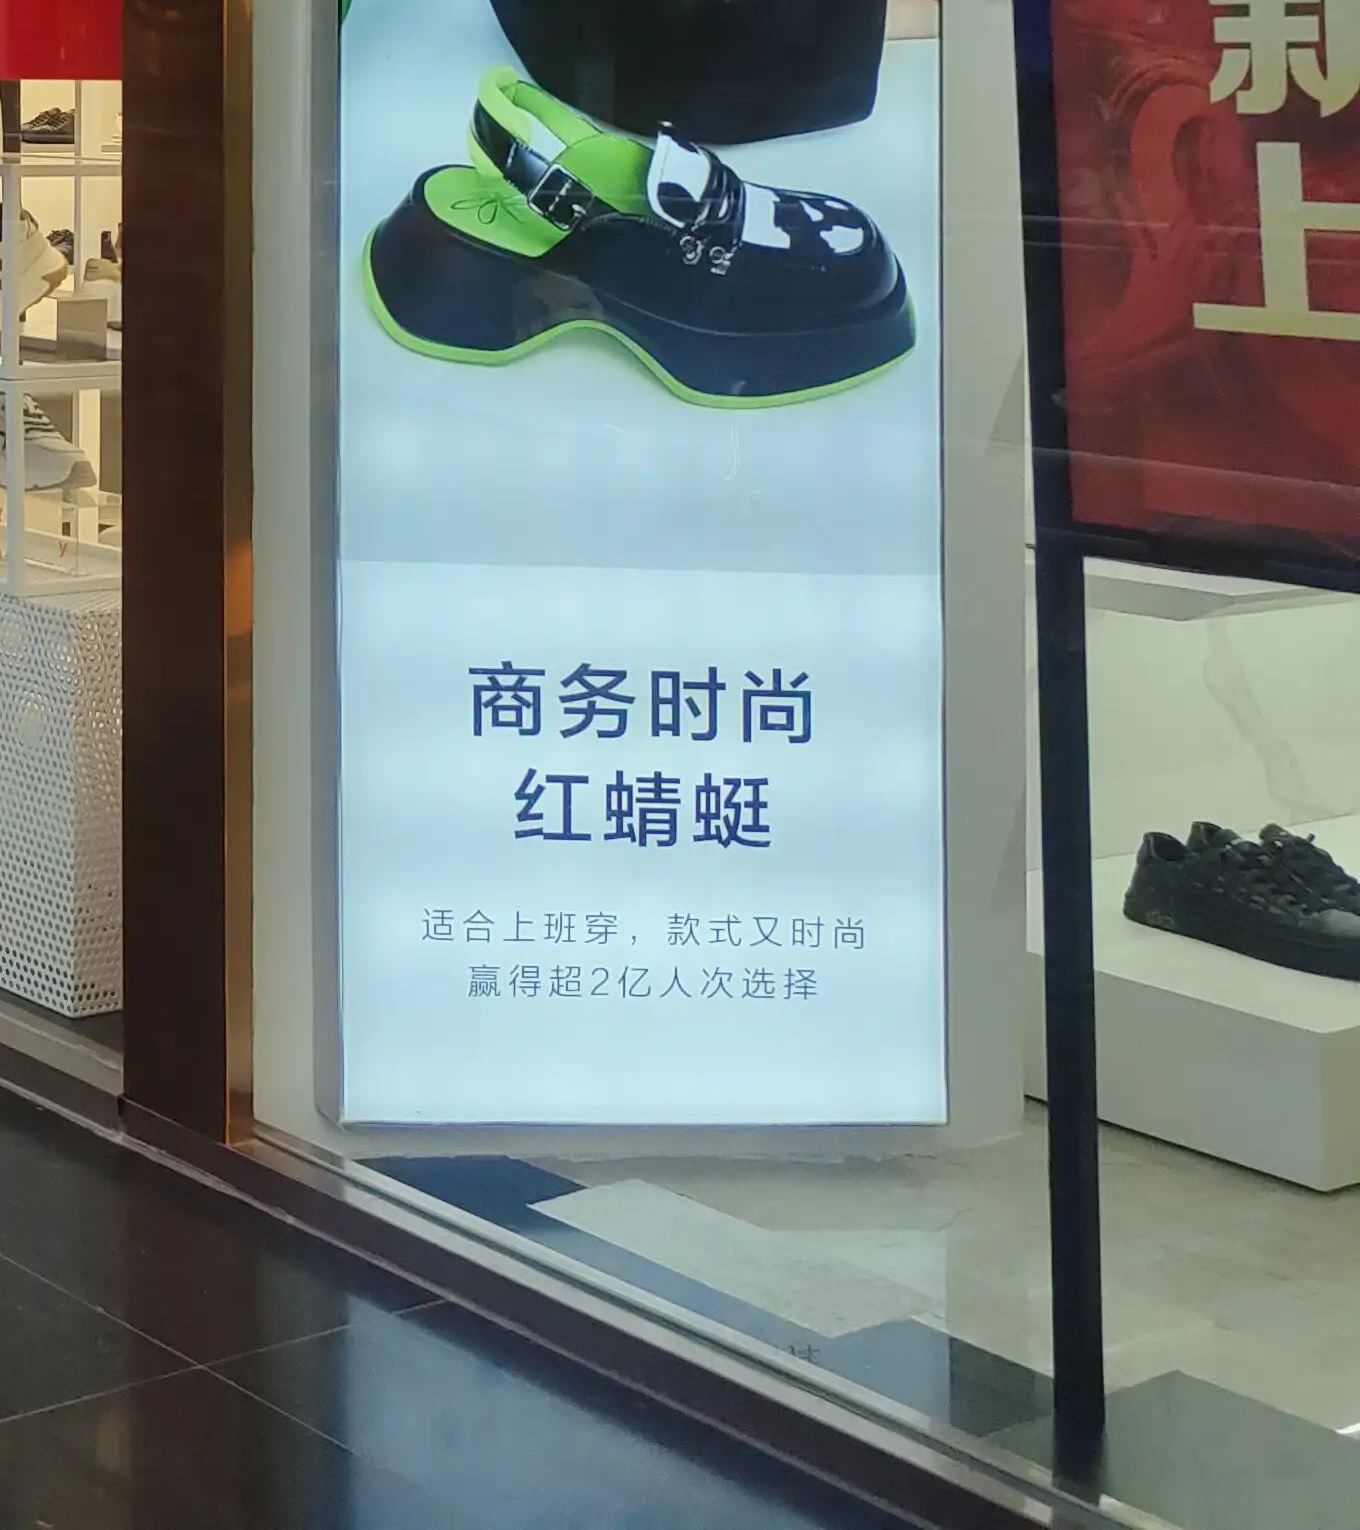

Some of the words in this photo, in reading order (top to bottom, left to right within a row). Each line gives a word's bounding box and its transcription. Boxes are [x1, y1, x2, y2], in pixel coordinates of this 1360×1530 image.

[1193, 142, 1360, 341] 上
[468, 661, 813, 744] 商务时尚
[513, 768, 772, 848] 红蜻蜓
[467, 964, 819, 1001] 赢得超2亿人次选择
